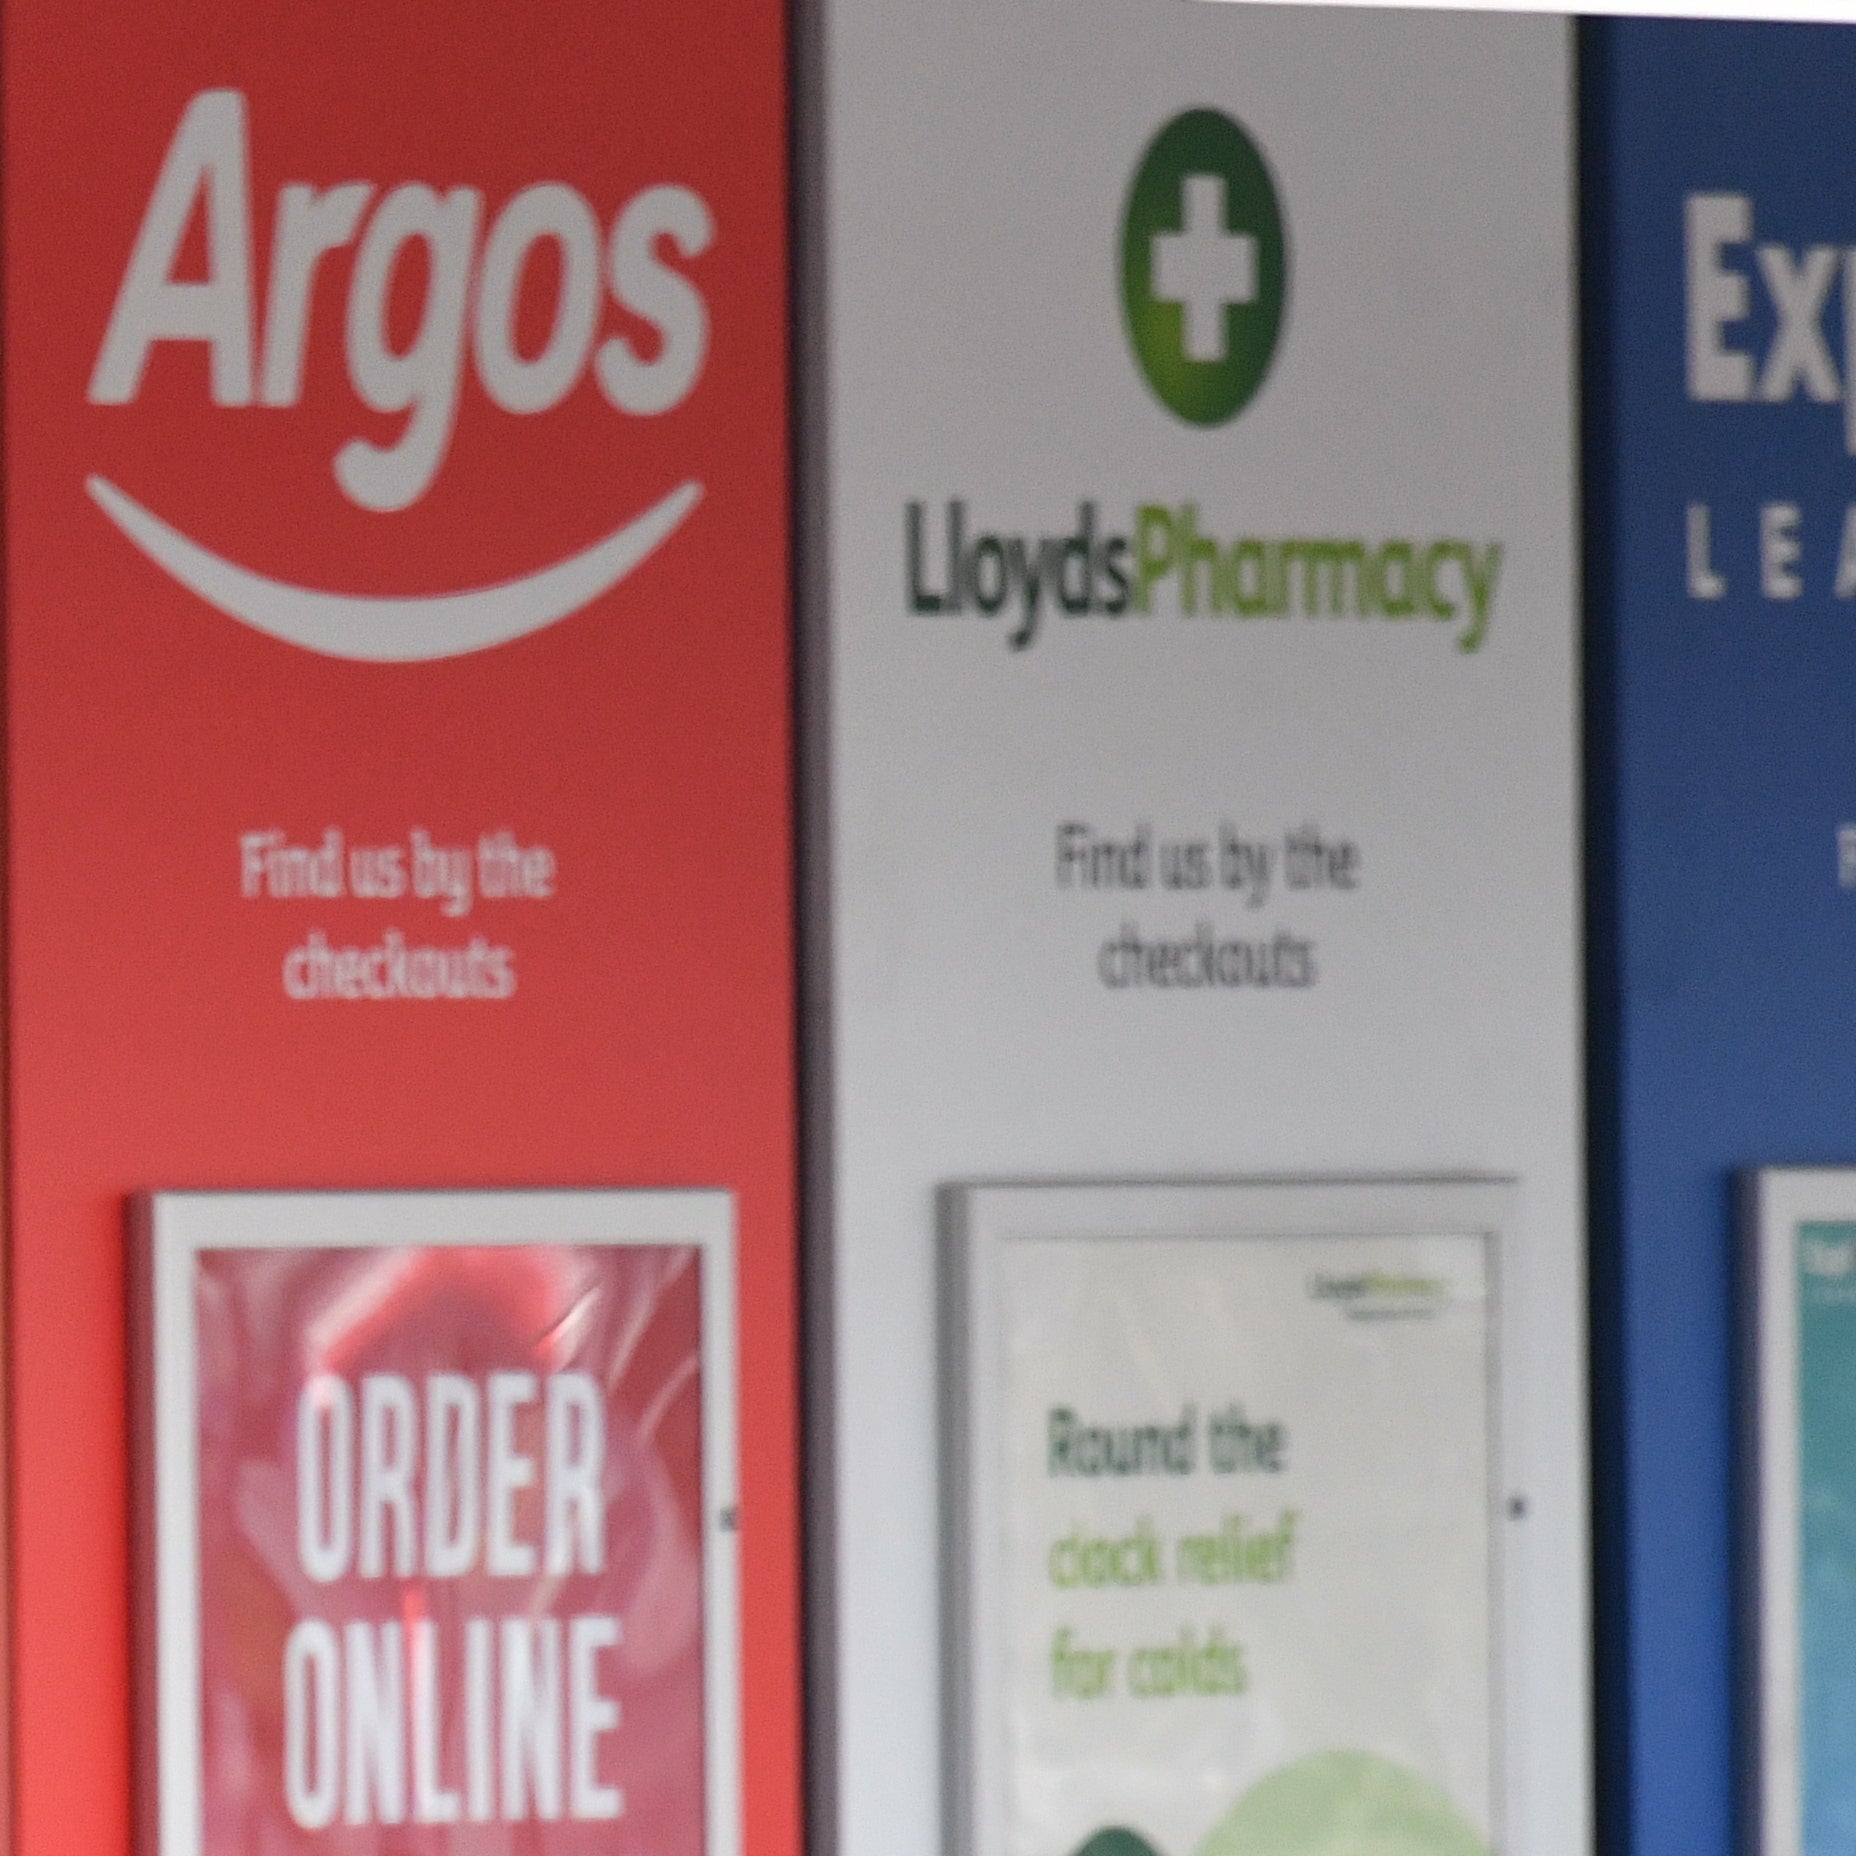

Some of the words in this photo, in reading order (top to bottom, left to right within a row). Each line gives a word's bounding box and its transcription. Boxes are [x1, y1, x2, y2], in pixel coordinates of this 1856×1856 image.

[88, 87, 716, 512] Argos
[905, 500, 1502, 653] LloydsPharmacy
[241, 829, 341, 899] Find
[350, 845, 404, 899] us
[413, 829, 473, 917] by
[477, 829, 556, 899] the
[1054, 822, 1150, 891] Find
[1160, 838, 1213, 891] us
[1218, 822, 1273, 908] by
[1282, 824, 1360, 890] the
[284, 930, 516, 1001] checkouts
[1097, 923, 1319, 990] checkouts
[298, 1370, 608, 1584] ORDER
[1048, 1408, 1196, 1478] Round
[1209, 1404, 1286, 1475] the
[1051, 1521, 1160, 1590] clock
[1178, 1510, 1300, 1585] relief
[1050, 1630, 1116, 1698] for
[1129, 1627, 1247, 1698] colds
[284, 1614, 624, 1831] ONLINE
